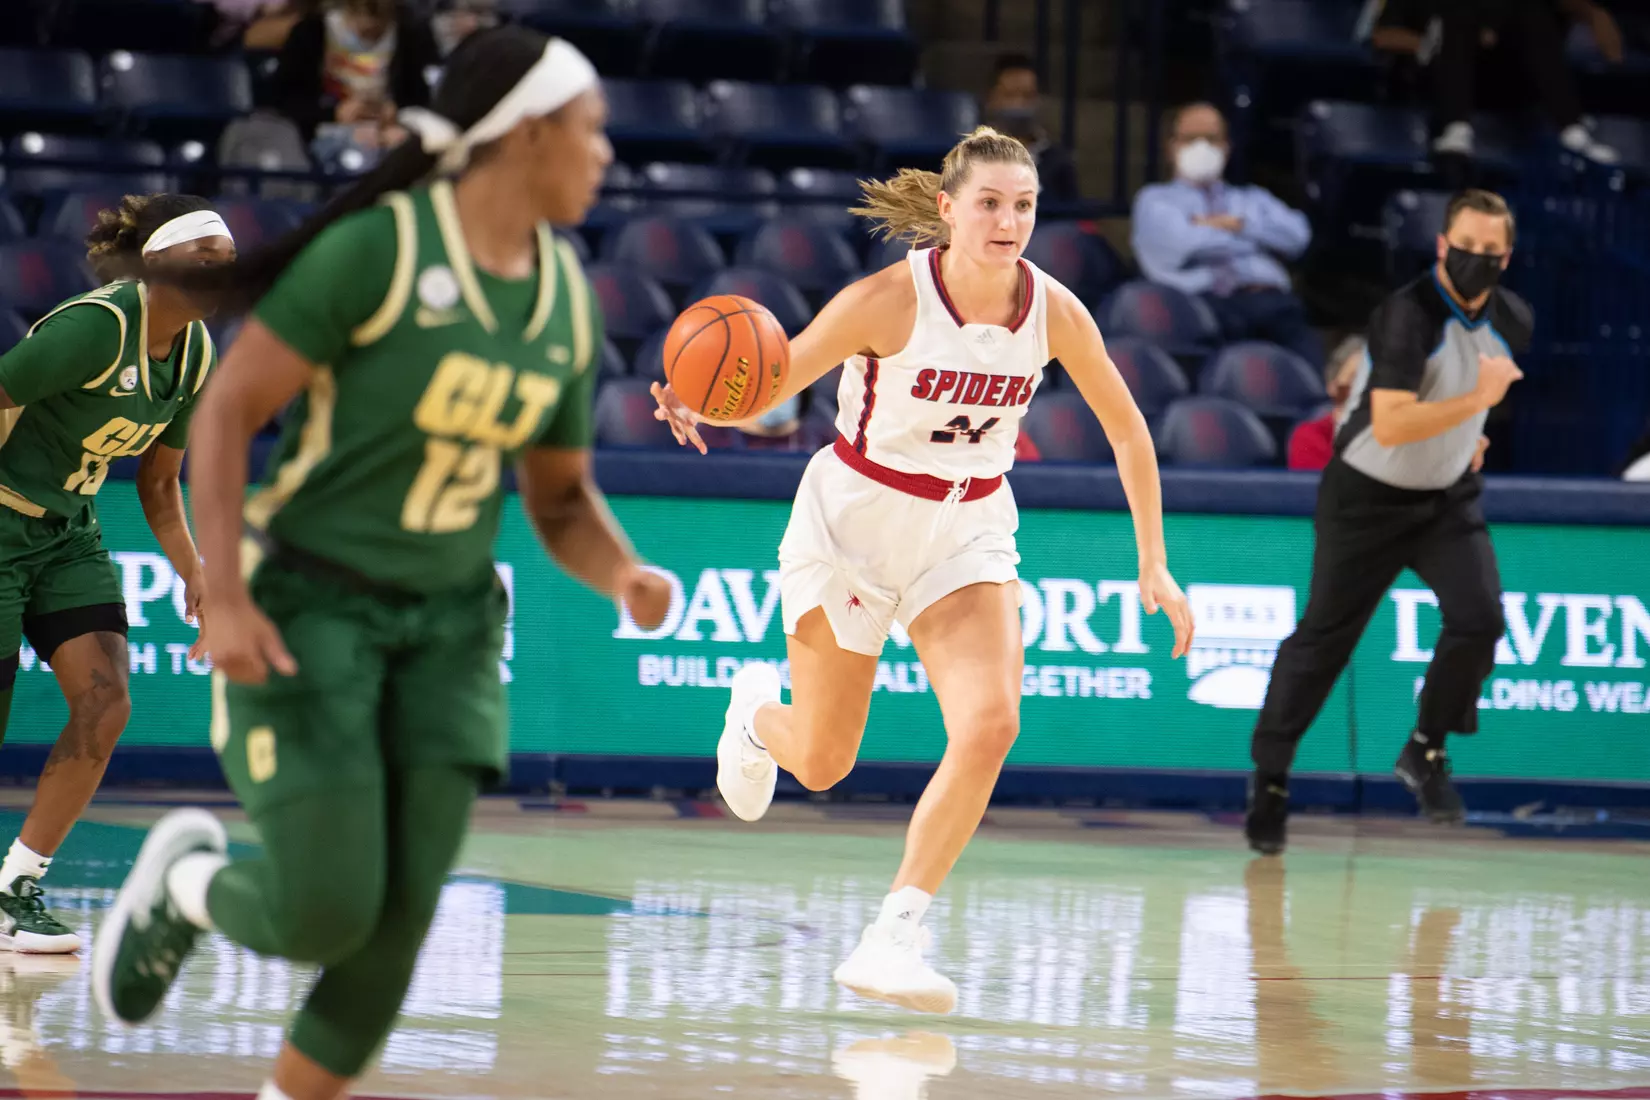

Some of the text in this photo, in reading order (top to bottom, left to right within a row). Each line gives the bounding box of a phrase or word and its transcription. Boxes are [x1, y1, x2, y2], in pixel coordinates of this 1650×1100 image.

[910, 367, 1036, 408] SPIDERS
[930, 414, 1002, 445] 24
[400, 437, 501, 534] 12
